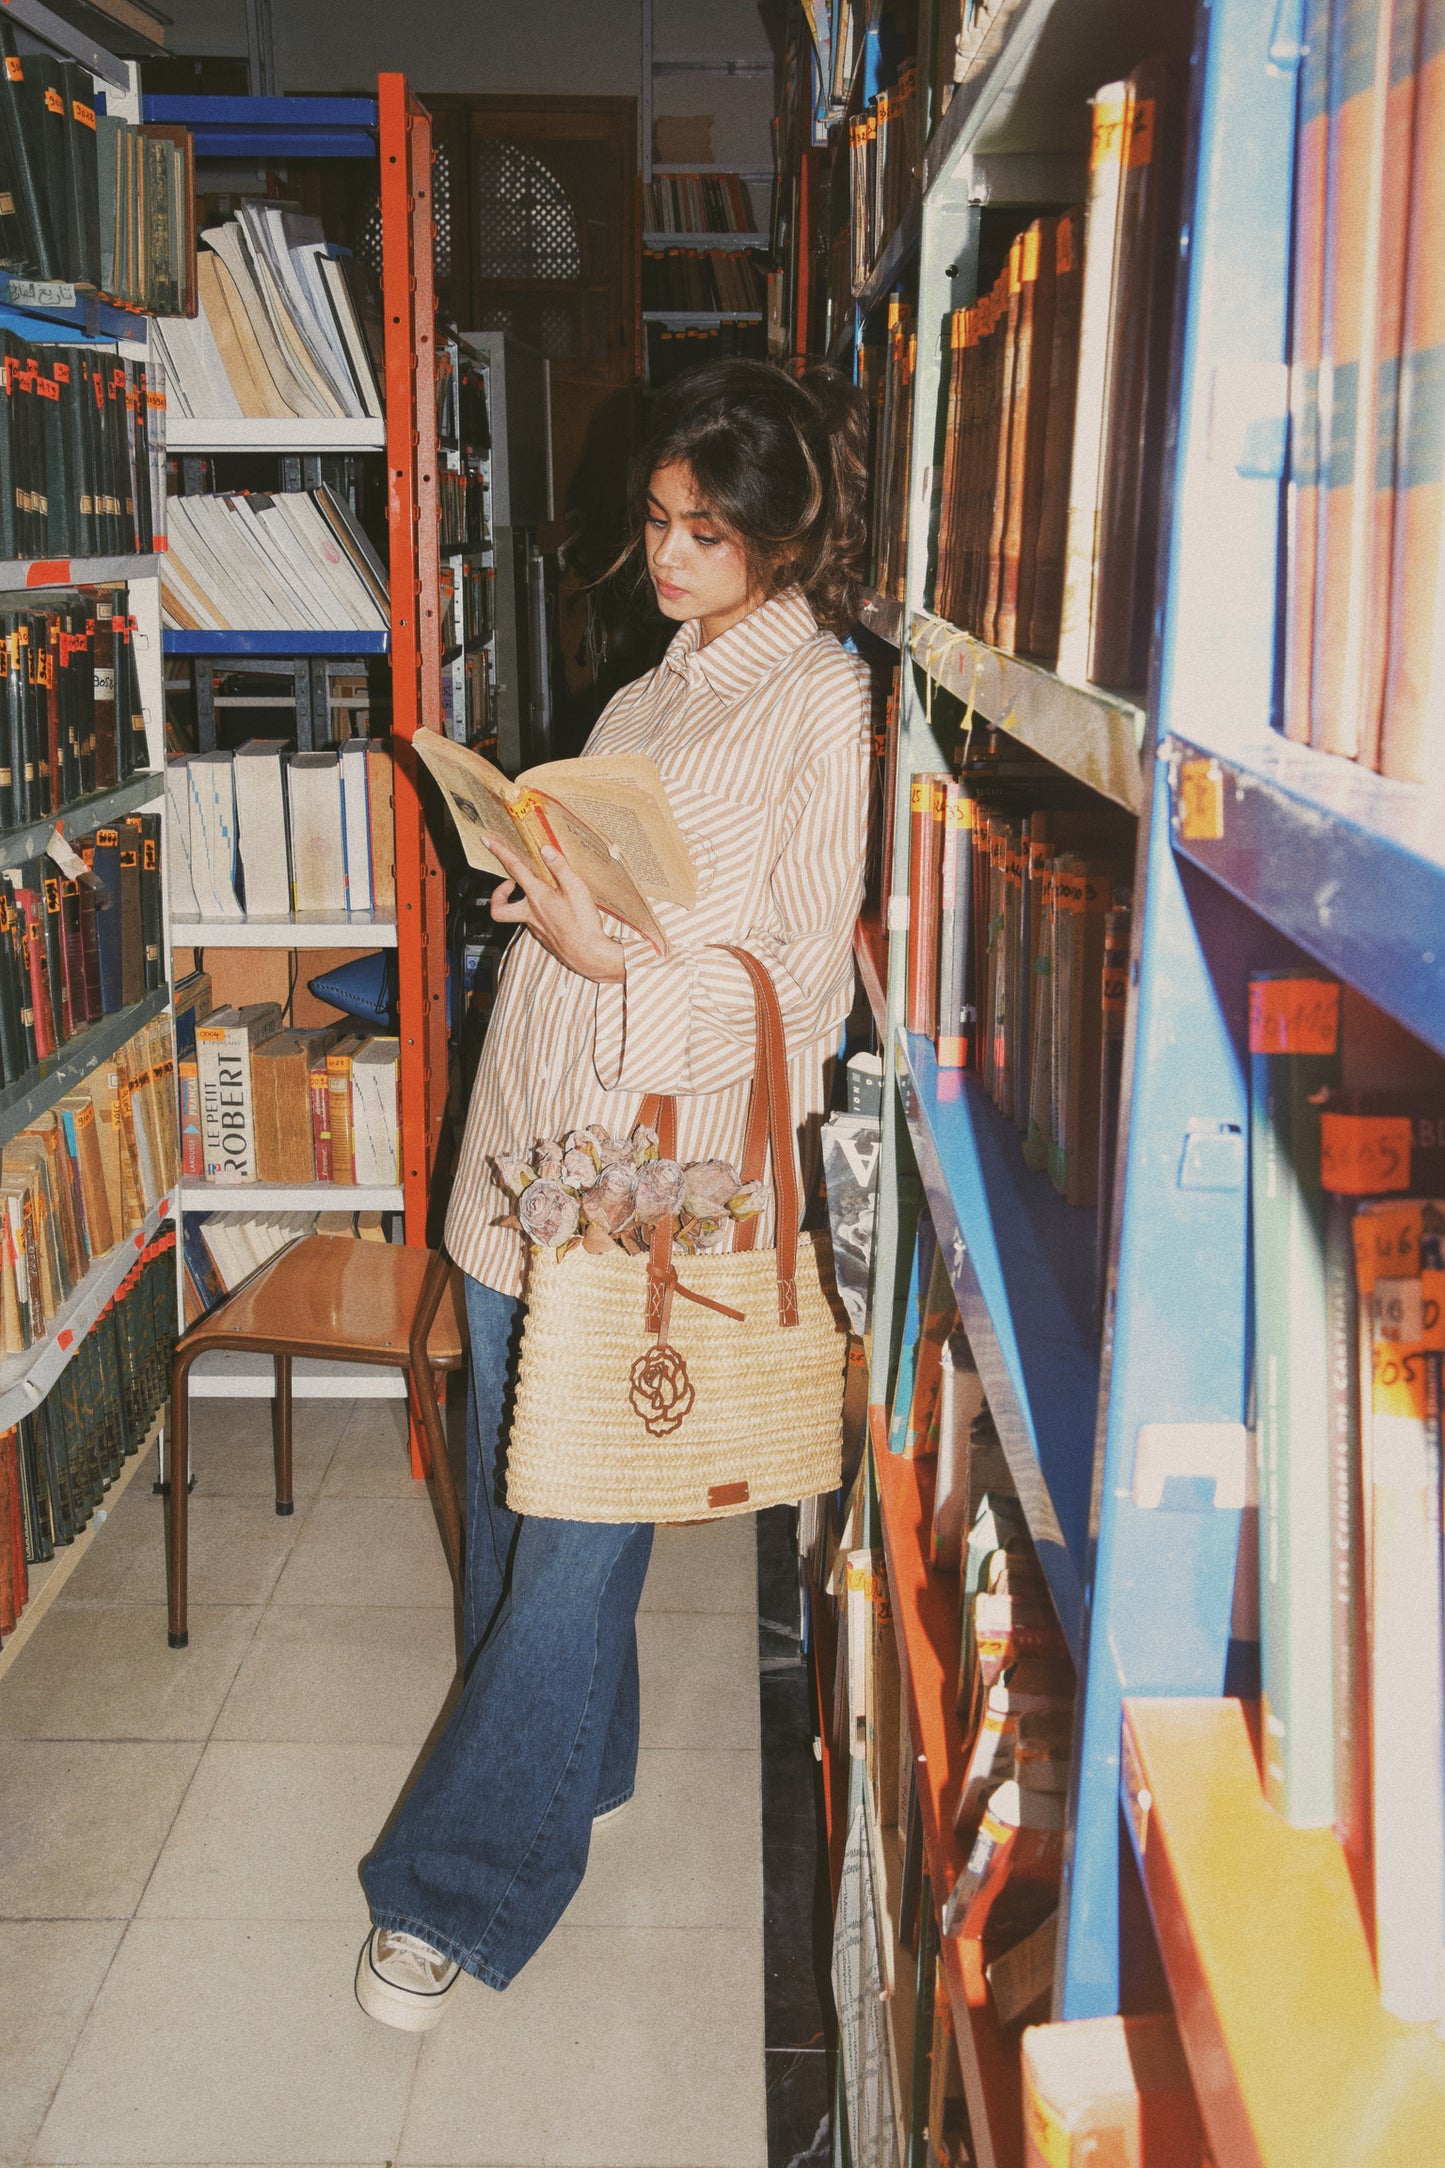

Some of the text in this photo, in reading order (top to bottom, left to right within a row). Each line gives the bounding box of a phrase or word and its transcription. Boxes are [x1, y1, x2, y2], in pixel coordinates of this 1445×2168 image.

[204, 1082, 220, 1148] LE PETIT
[218, 1051, 248, 1177] ROBERT
